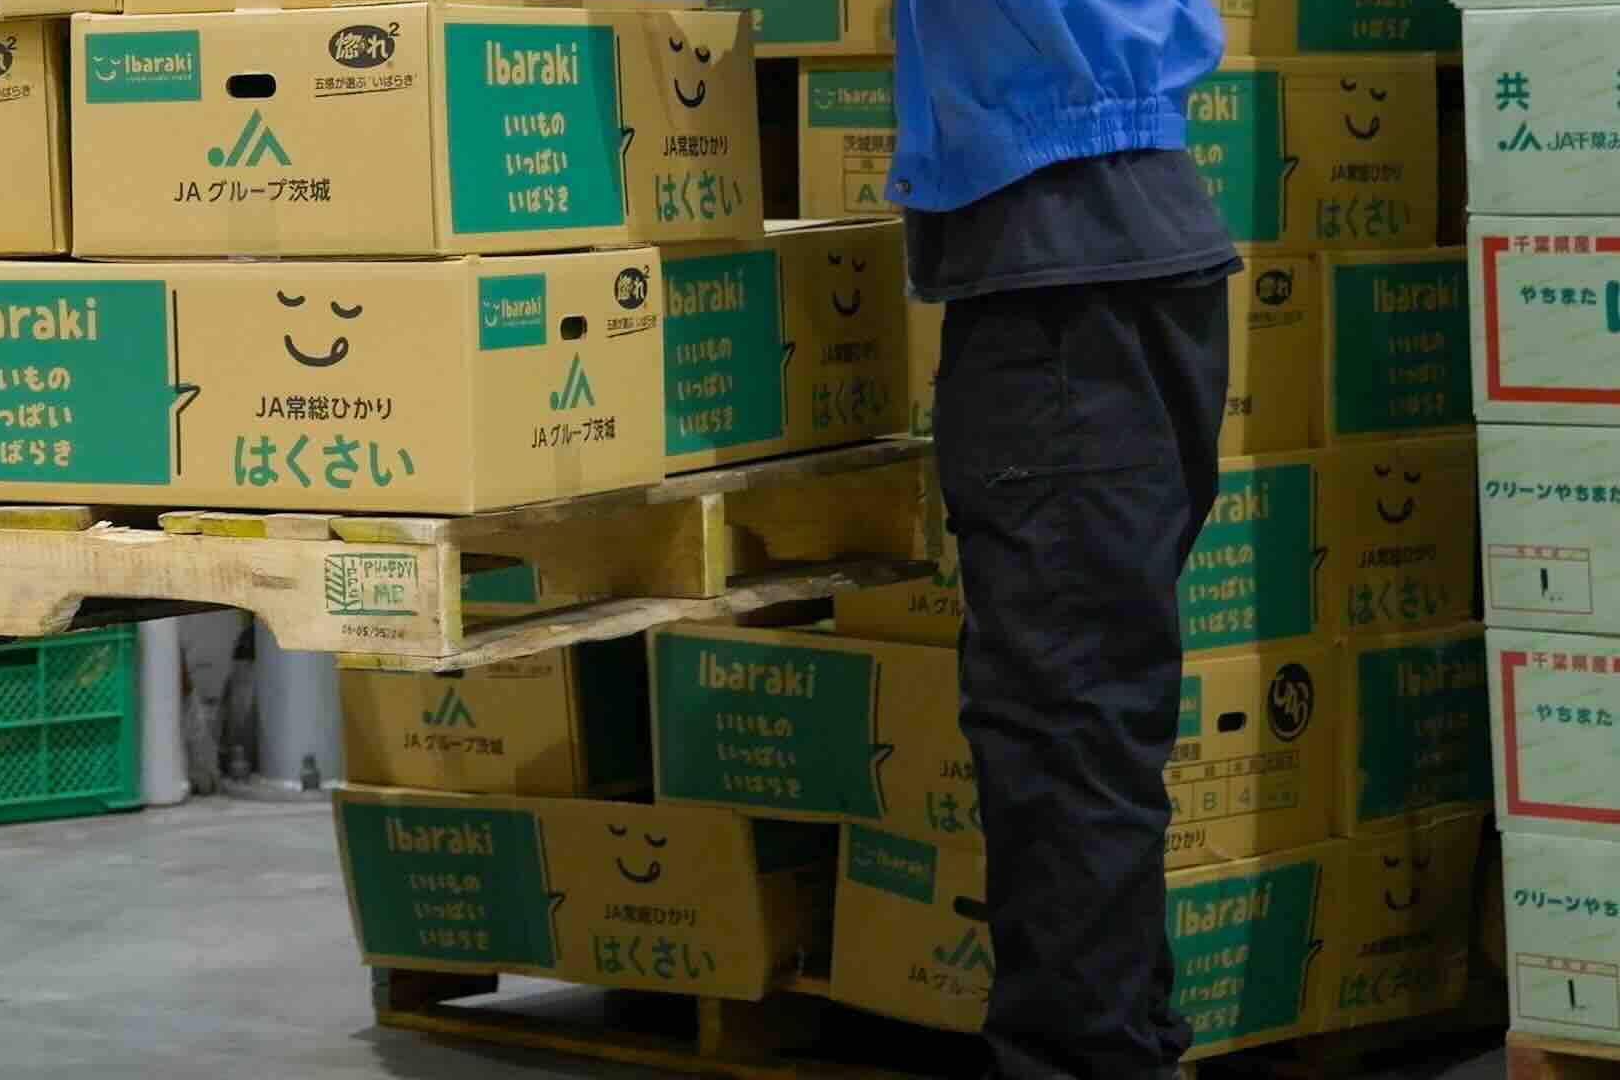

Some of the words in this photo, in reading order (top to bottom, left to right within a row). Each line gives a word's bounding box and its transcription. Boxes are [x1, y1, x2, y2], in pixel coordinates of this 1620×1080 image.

[125, 53, 192, 72] Ibaraki
[485, 40, 578, 87] Ibaraki
[1188, 85, 1238, 121] raki
[1496, 72, 1530, 111] 共
[503, 113, 566, 137] いいもの
[662, 135, 729, 157] JA常総ひかり
[508, 185, 569, 213] いばらき
[655, 175, 742, 223] はくさい
[858, 183, 876, 201] A
[1317, 198, 1412, 239] はくさい
[501, 297, 542, 320] Ibaraki
[1520, 286, 1596, 306] やちまた
[255, 397, 393, 421] JA常総ひかり
[235, 434, 415, 489] はくさい
[699, 652, 816, 699] Ibaraki
[1535, 704, 1613, 727] やちまた
[388, 820, 493, 857] Ibaraki
[1175, 883, 1272, 937] Ibaraki
[593, 936, 716, 980] はくさい
